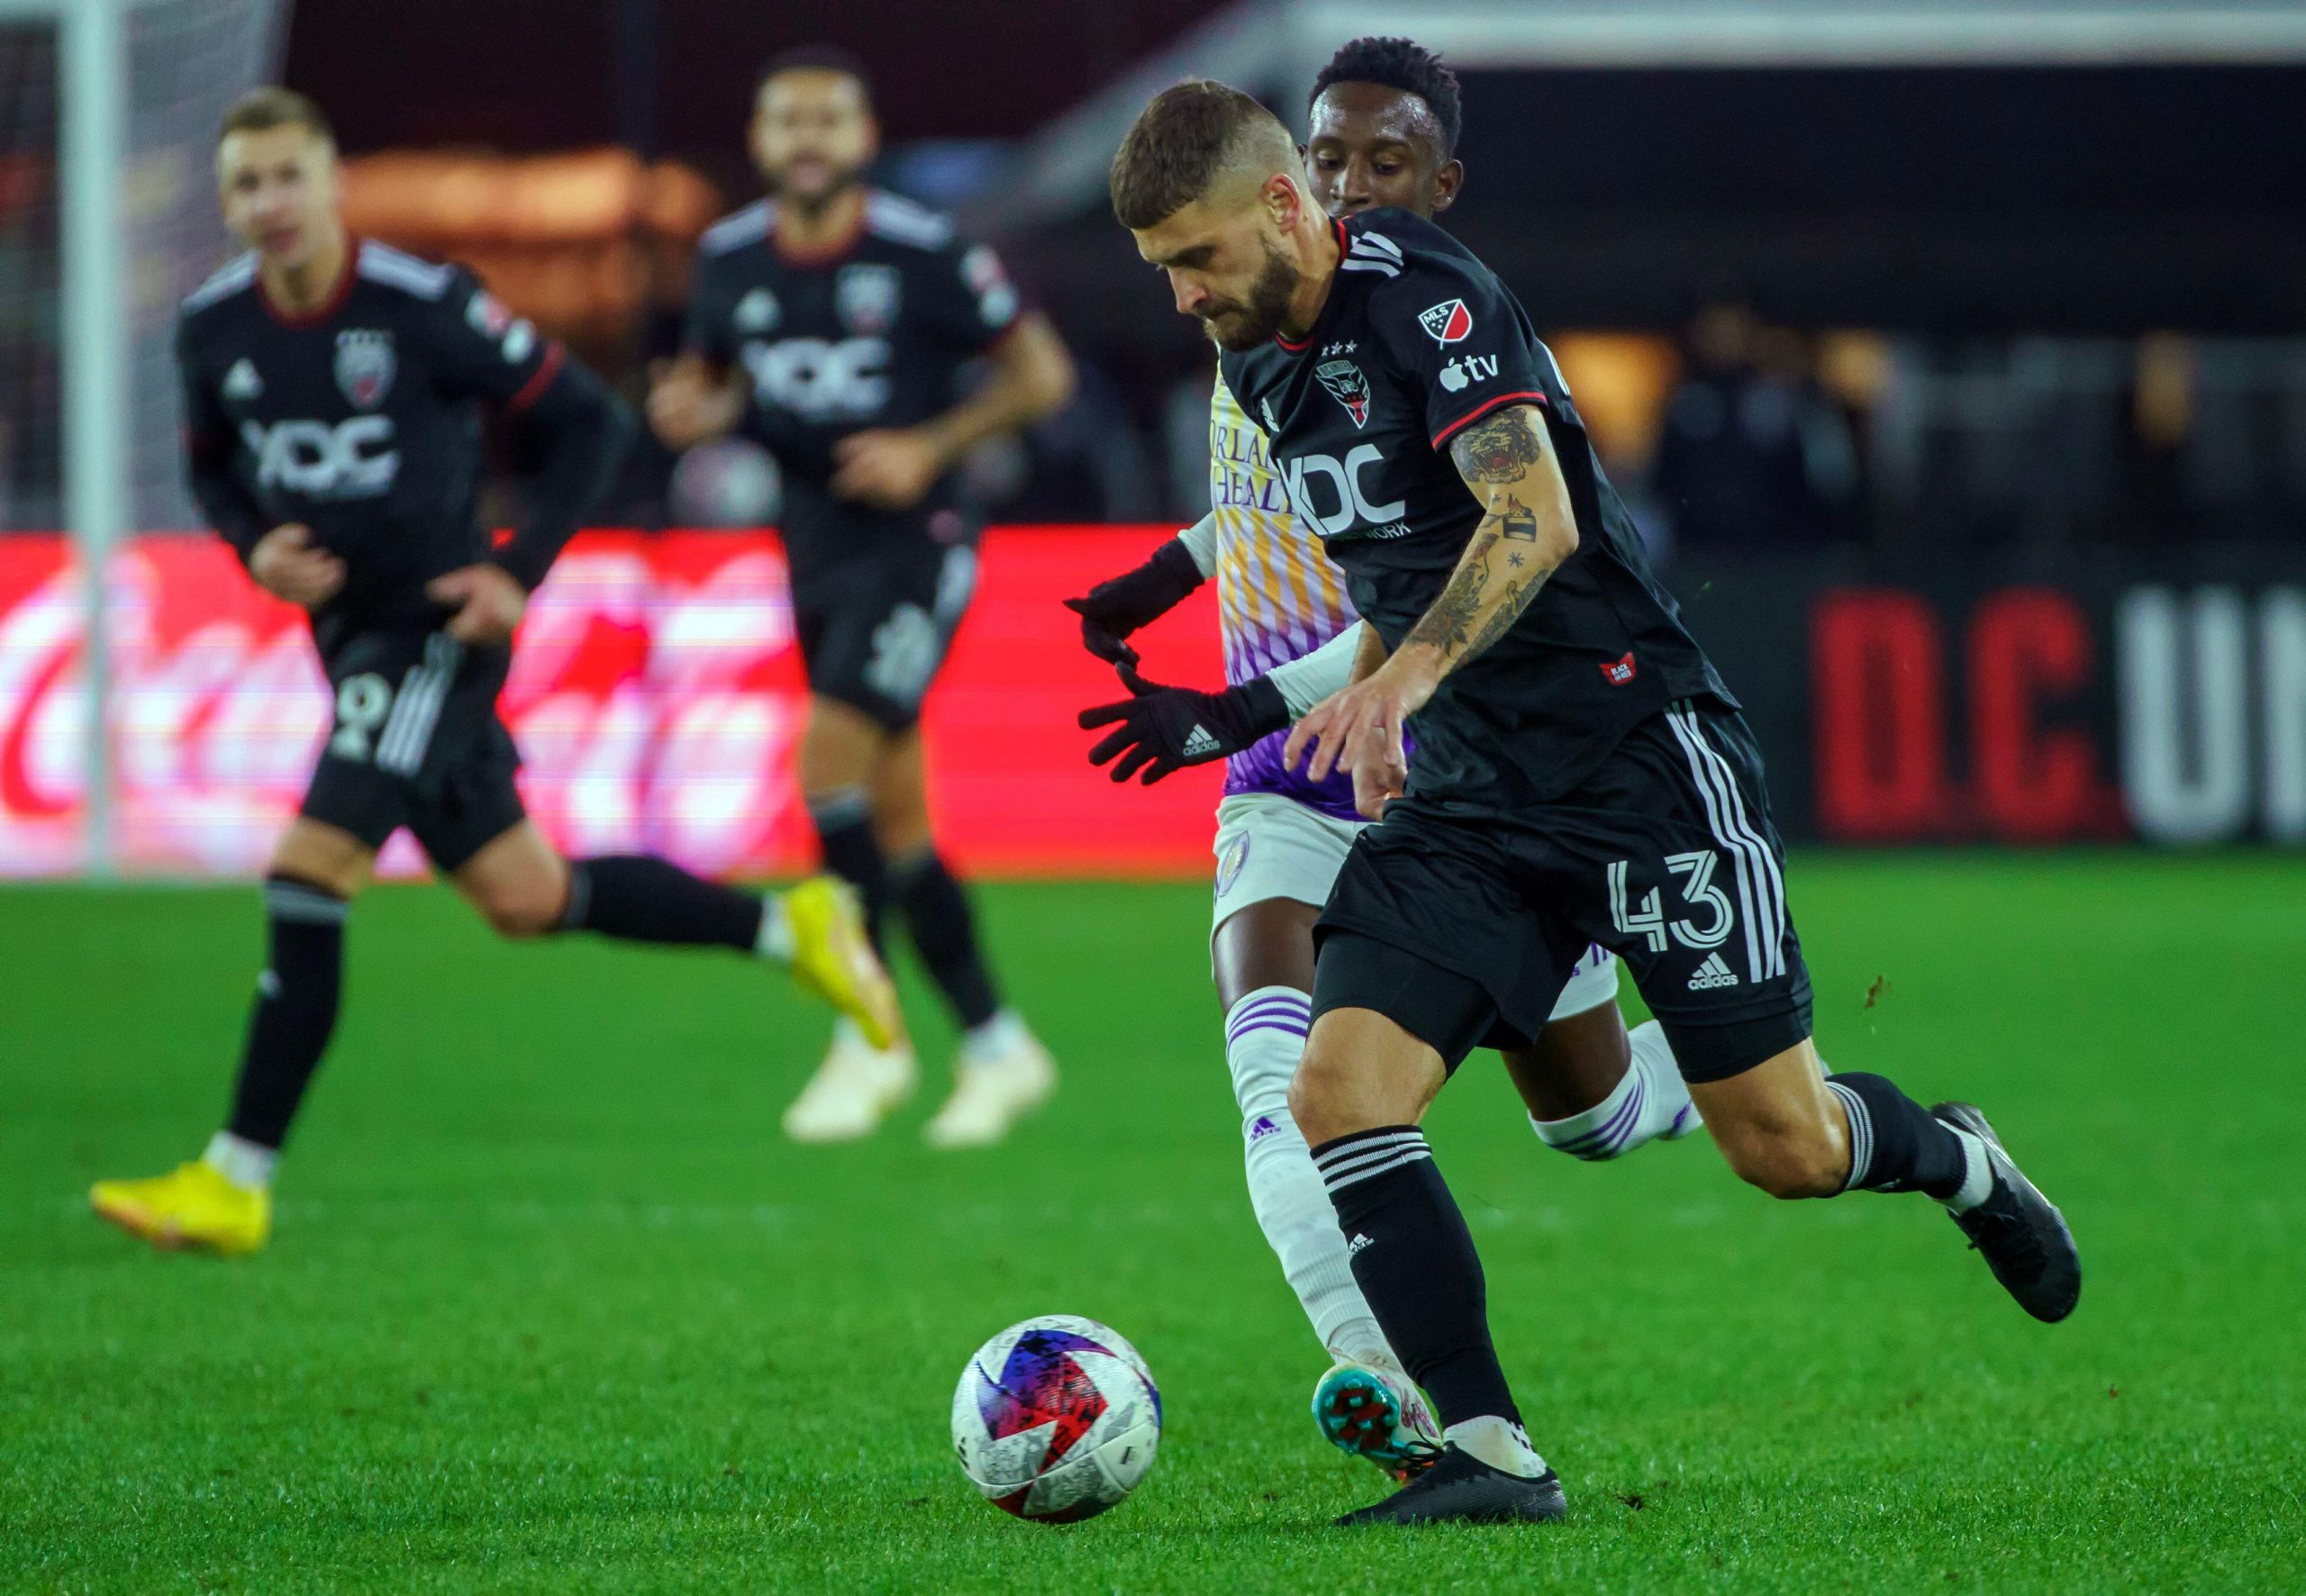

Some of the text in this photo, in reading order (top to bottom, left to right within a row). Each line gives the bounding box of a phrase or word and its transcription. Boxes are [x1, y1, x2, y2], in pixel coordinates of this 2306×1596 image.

[1423, 306, 1448, 324] MLS
[1465, 354, 1498, 381] tv
[1183, 739, 1221, 756] adidas
[1607, 849, 1734, 952] 43
[1688, 974, 1739, 991] adidas
